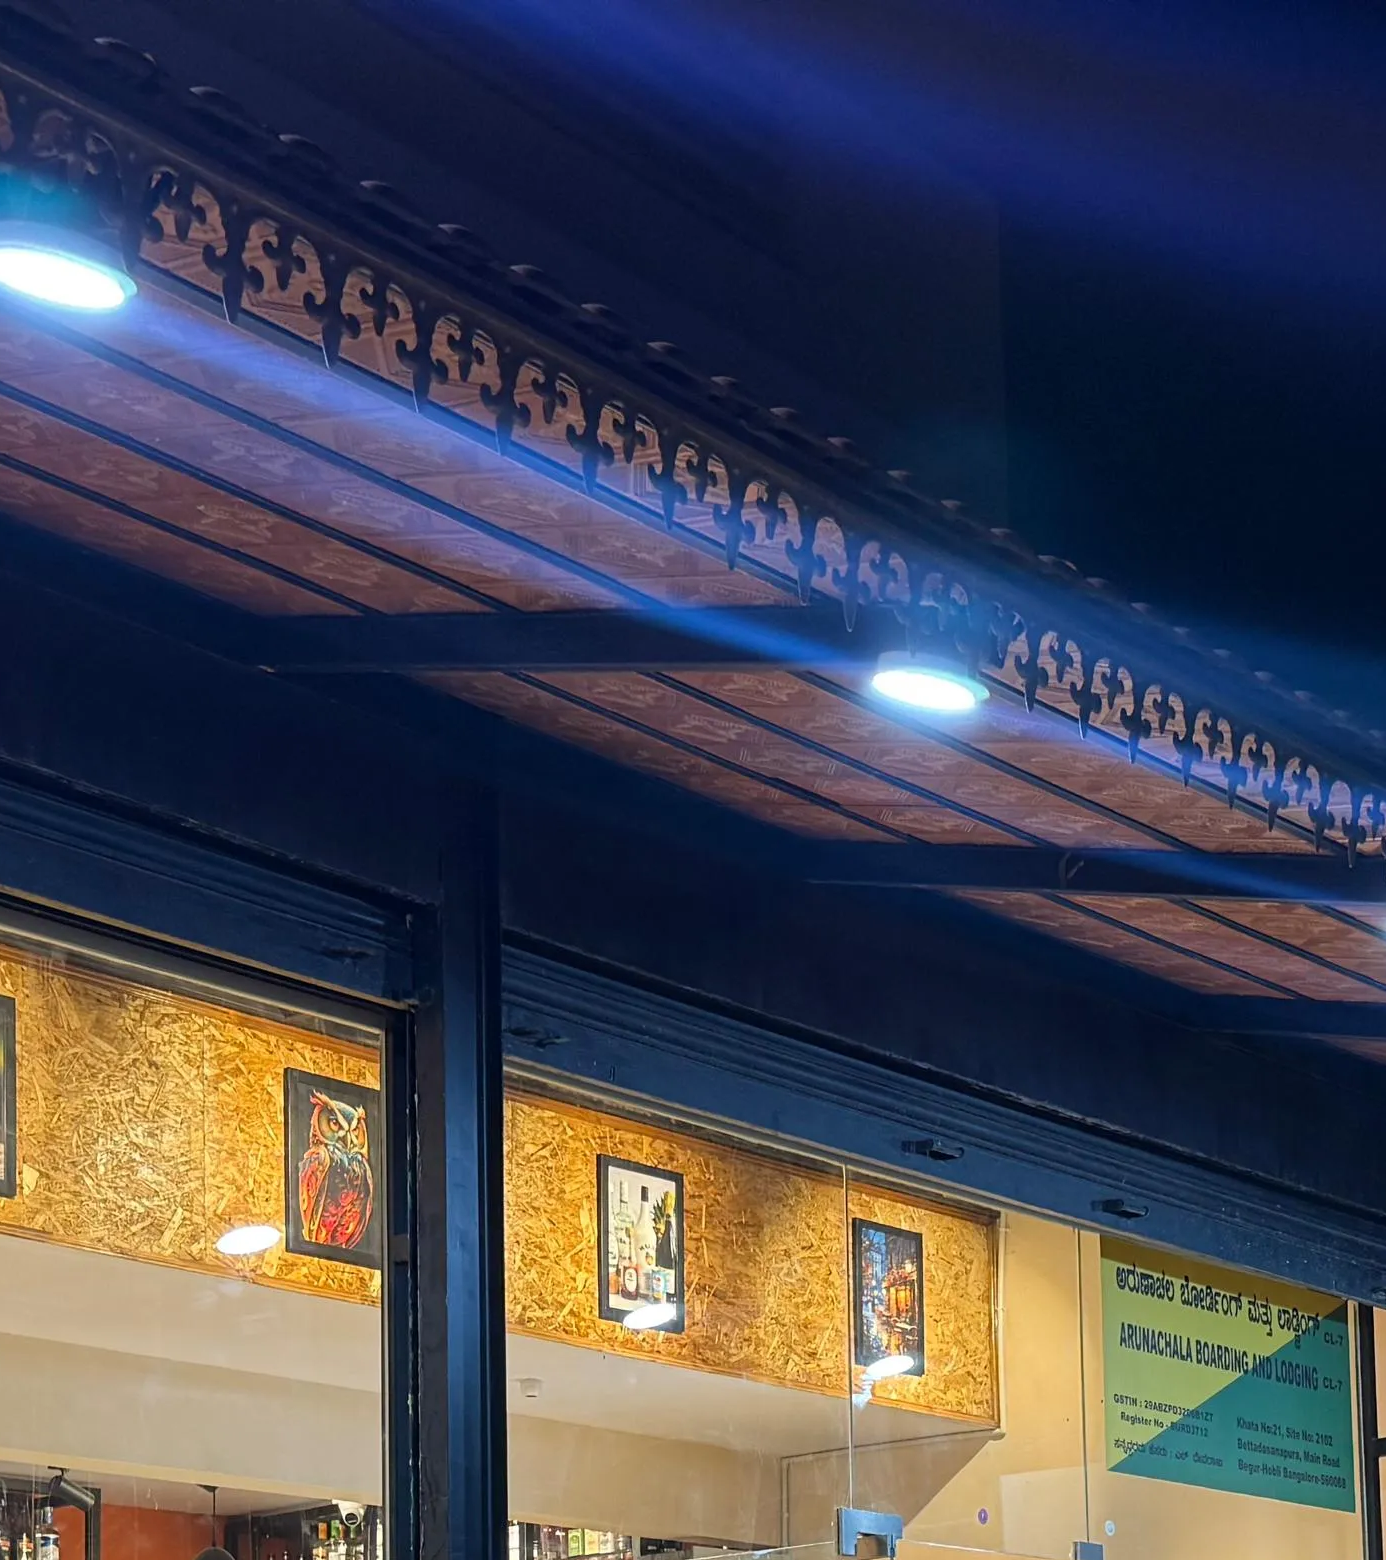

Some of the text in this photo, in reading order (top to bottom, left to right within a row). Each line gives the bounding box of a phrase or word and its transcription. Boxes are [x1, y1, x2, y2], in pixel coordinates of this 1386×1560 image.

[1324, 1331, 1344, 1347] CL-7
[1119, 1321, 1343, 1393] ARUNACHALA BOARDING AND LODGING CL-7
[1113, 1393, 1138, 1407] GSTIN
[1120, 1411, 1152, 1426] Register
